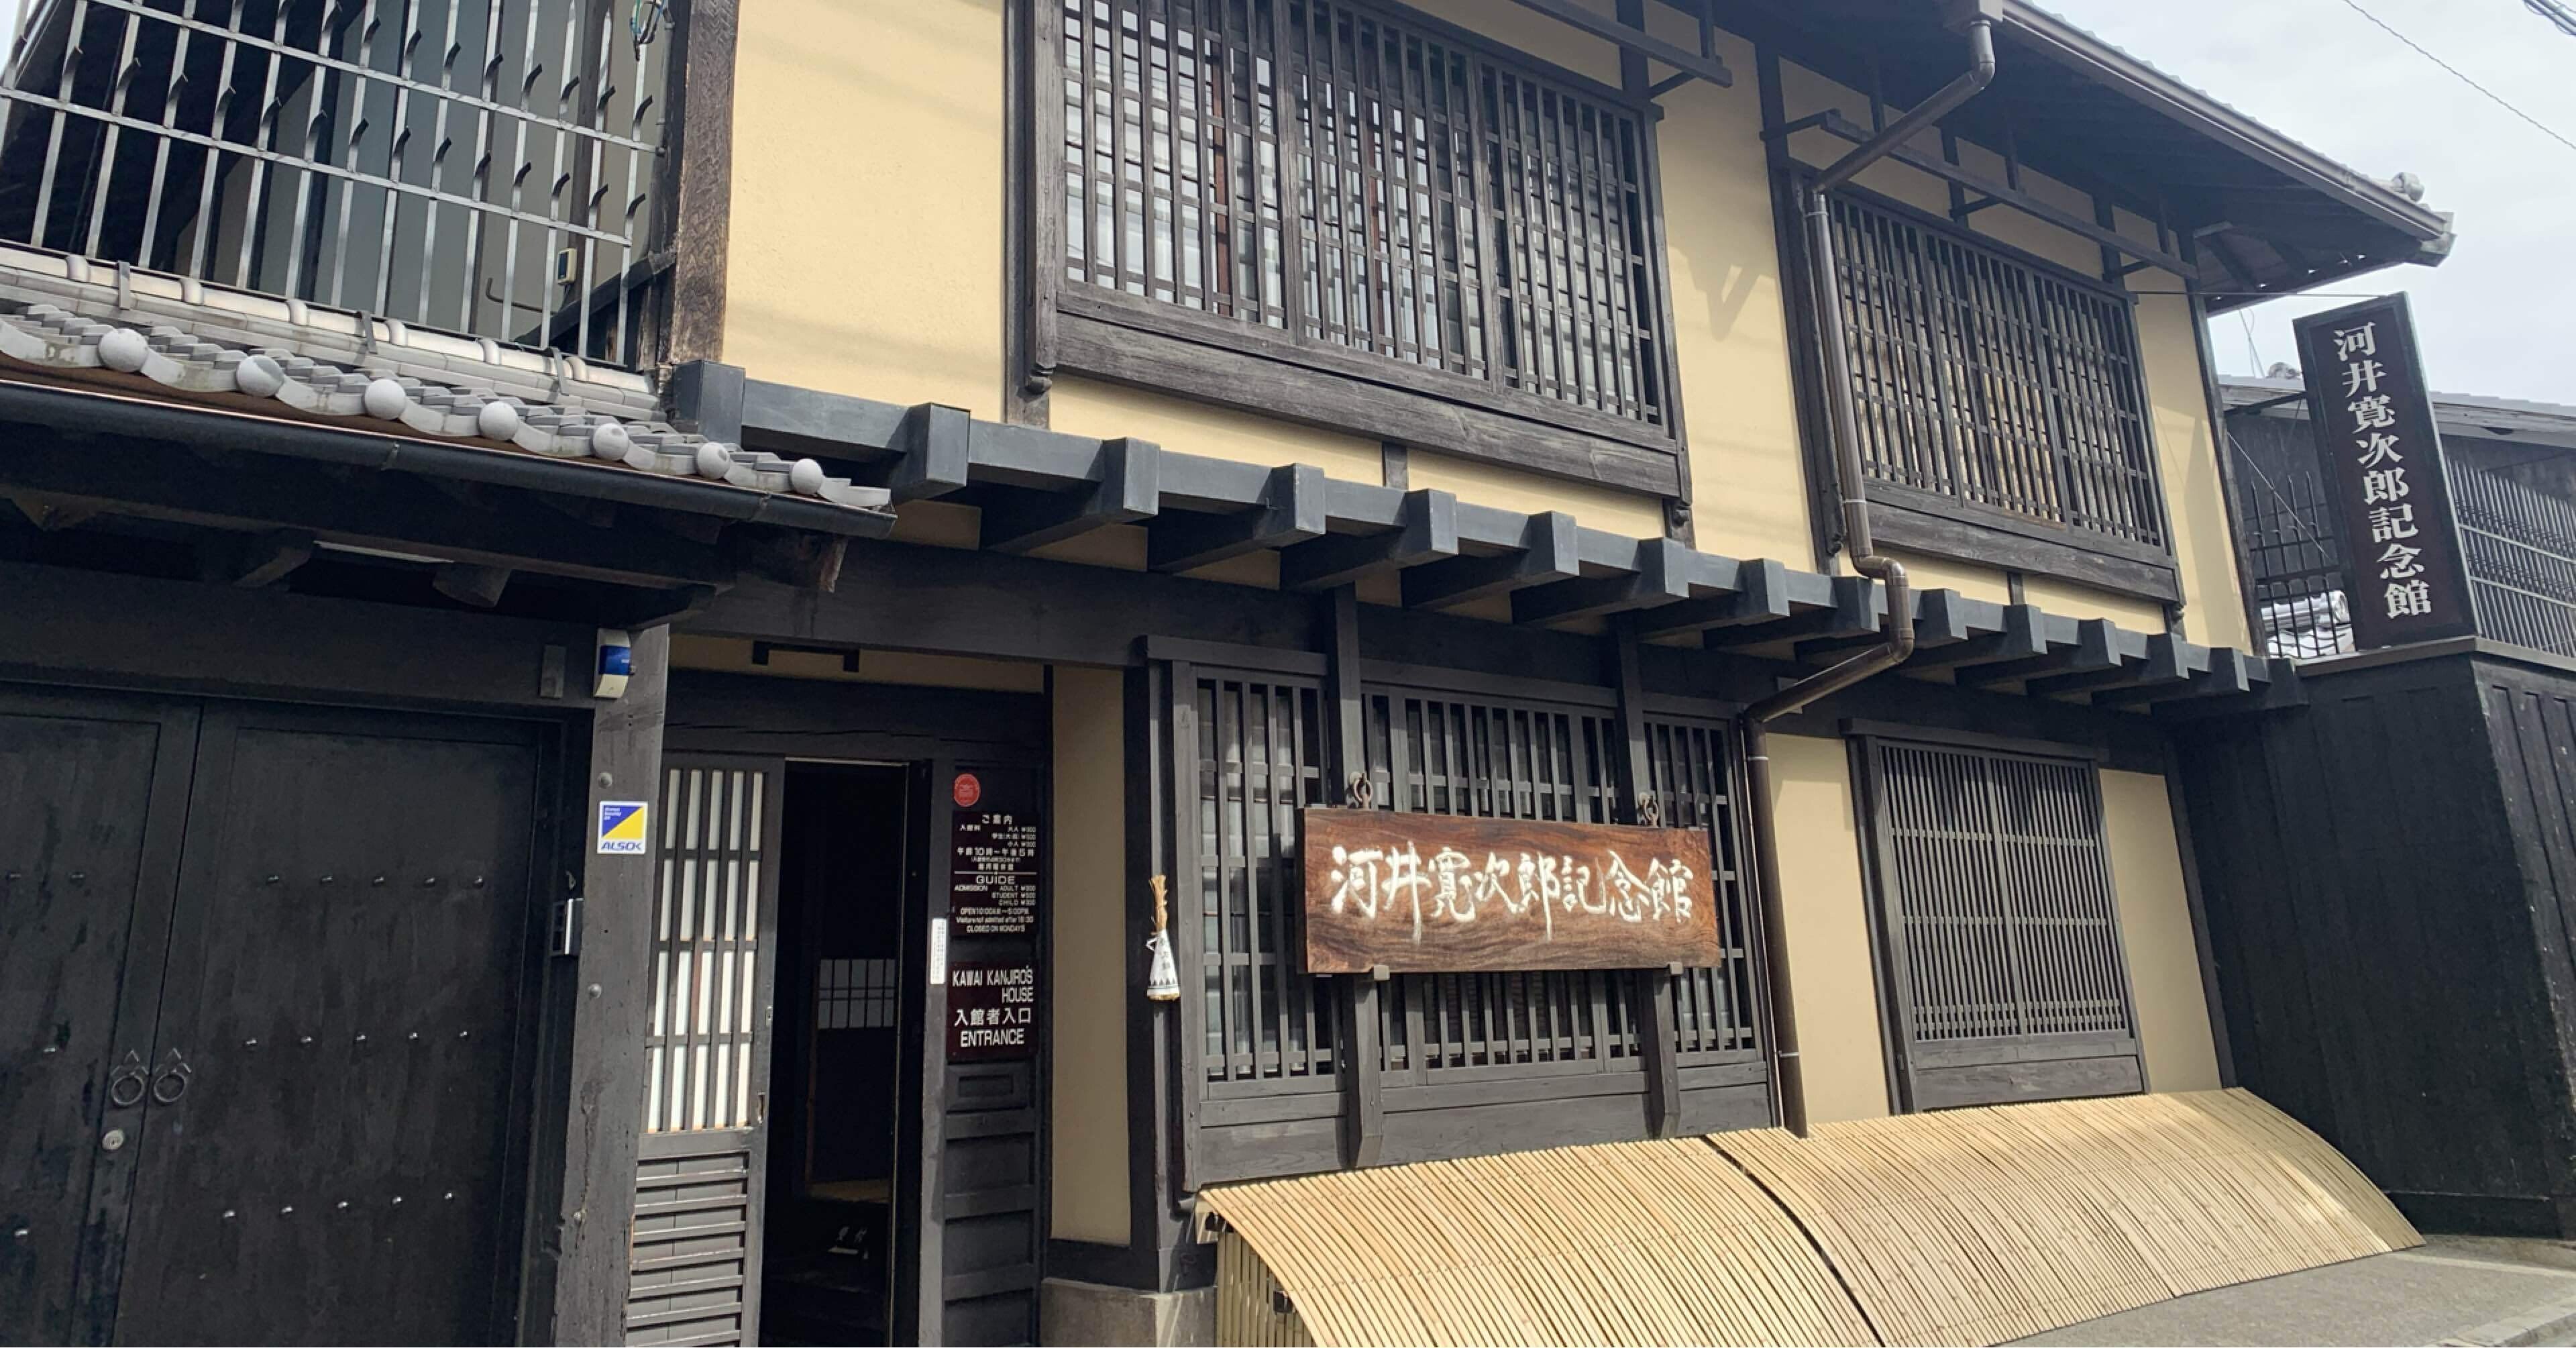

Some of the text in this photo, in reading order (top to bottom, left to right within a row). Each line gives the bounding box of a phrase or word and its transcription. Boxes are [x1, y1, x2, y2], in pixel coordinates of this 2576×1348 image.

[981, 814, 1012, 825] ご案内
[602, 841, 642, 851] ALSOK
[976, 875, 1015, 884] GUIDE
[967, 925, 989, 933] CLOSED
[999, 924, 1026, 932] MONDAYS
[952, 965, 1034, 987] KAWAI KANJIRO'S
[1002, 986, 1034, 1003] HOUSE
[954, 1007, 1031, 1027] 入館者入口
[960, 1028, 1024, 1047] ENTRANCE
